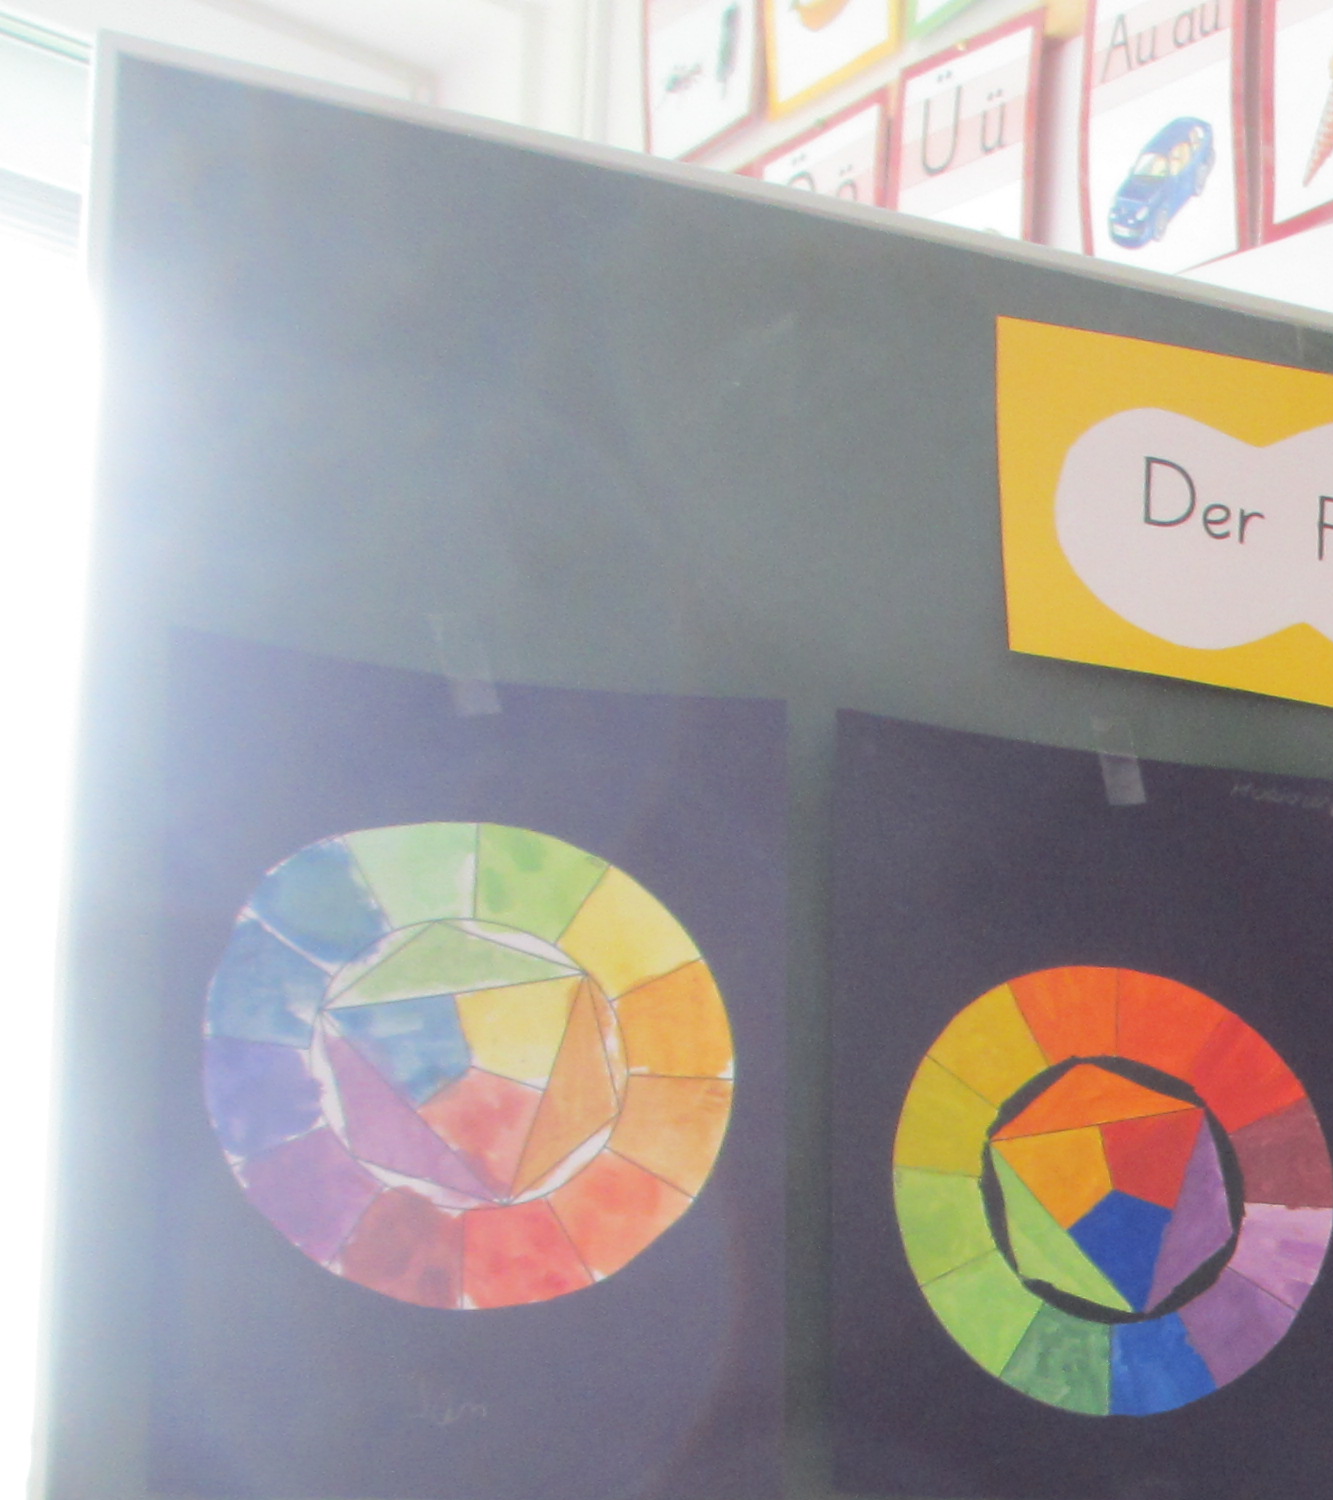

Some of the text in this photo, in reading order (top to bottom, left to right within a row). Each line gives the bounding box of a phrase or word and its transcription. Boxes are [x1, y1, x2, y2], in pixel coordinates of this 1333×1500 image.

[1100, 13, 1157, 83] Au
[921, 69, 963, 175] Ü
[1142, 454, 1266, 544] Der
